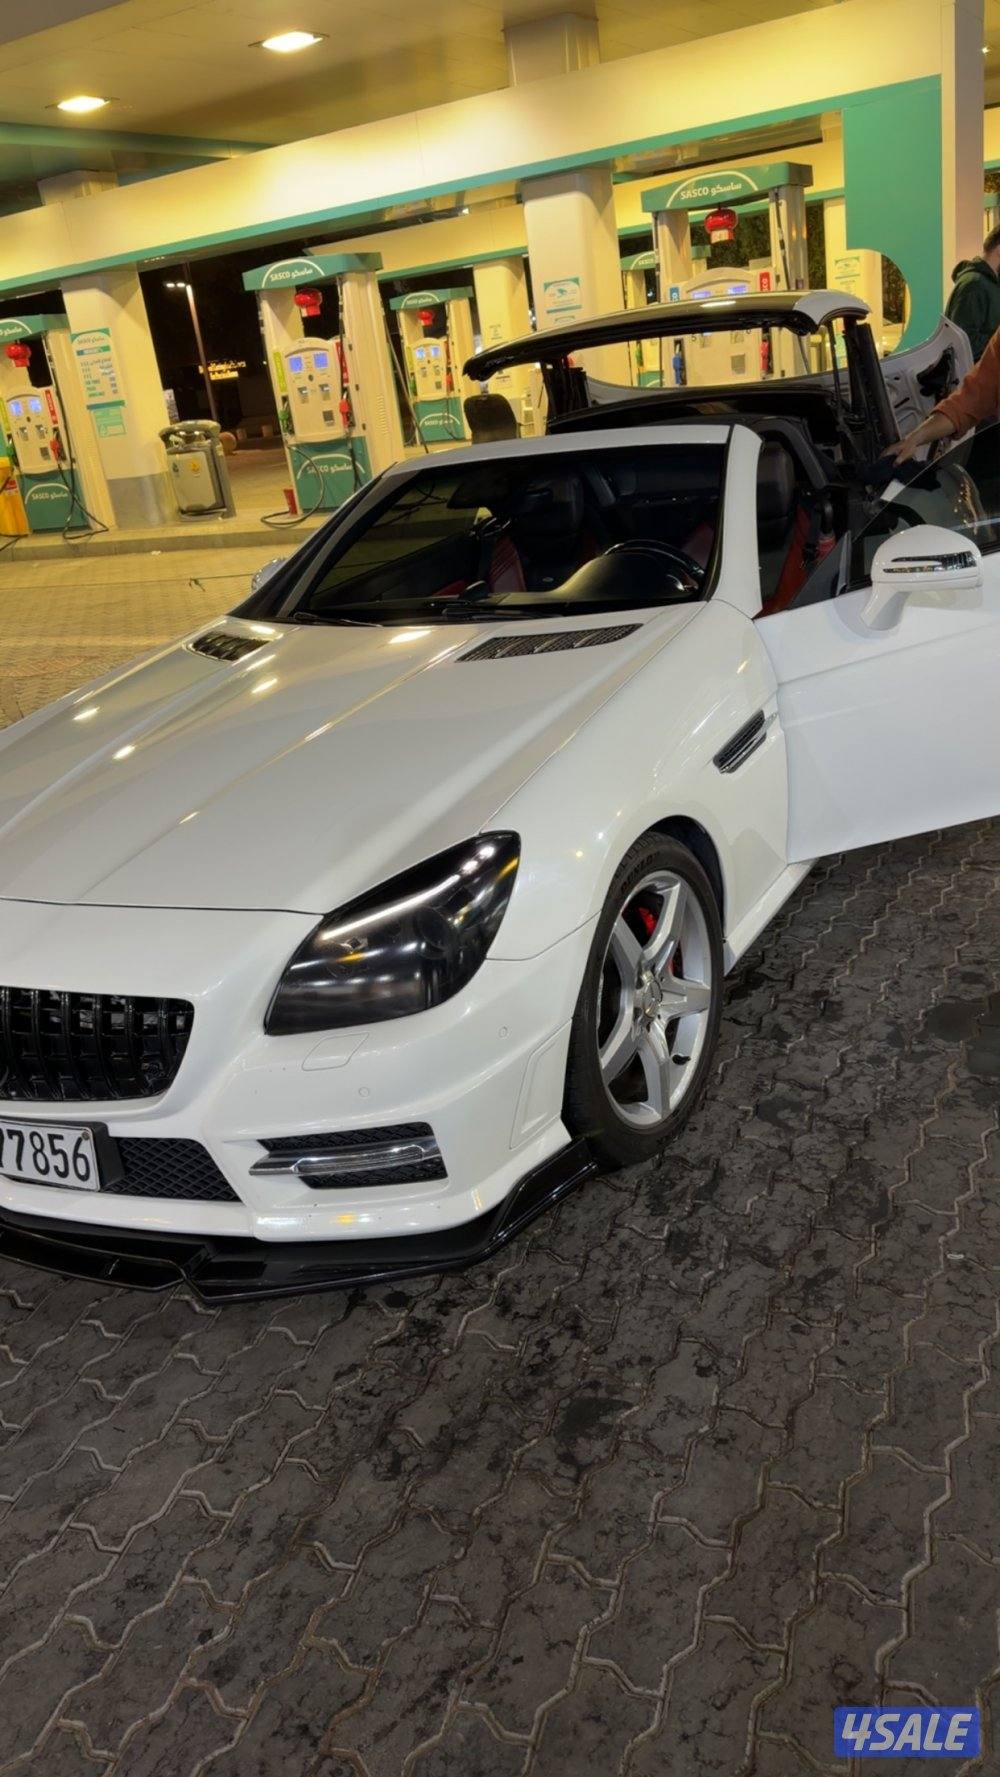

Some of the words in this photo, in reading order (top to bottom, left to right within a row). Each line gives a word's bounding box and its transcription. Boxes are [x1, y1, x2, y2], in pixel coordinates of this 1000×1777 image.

[680, 186, 709, 200] SASCO
[710, 182, 742, 197] ساسكو
[270, 271, 290, 282] SASCO
[31, 492, 50, 501] SASCO
